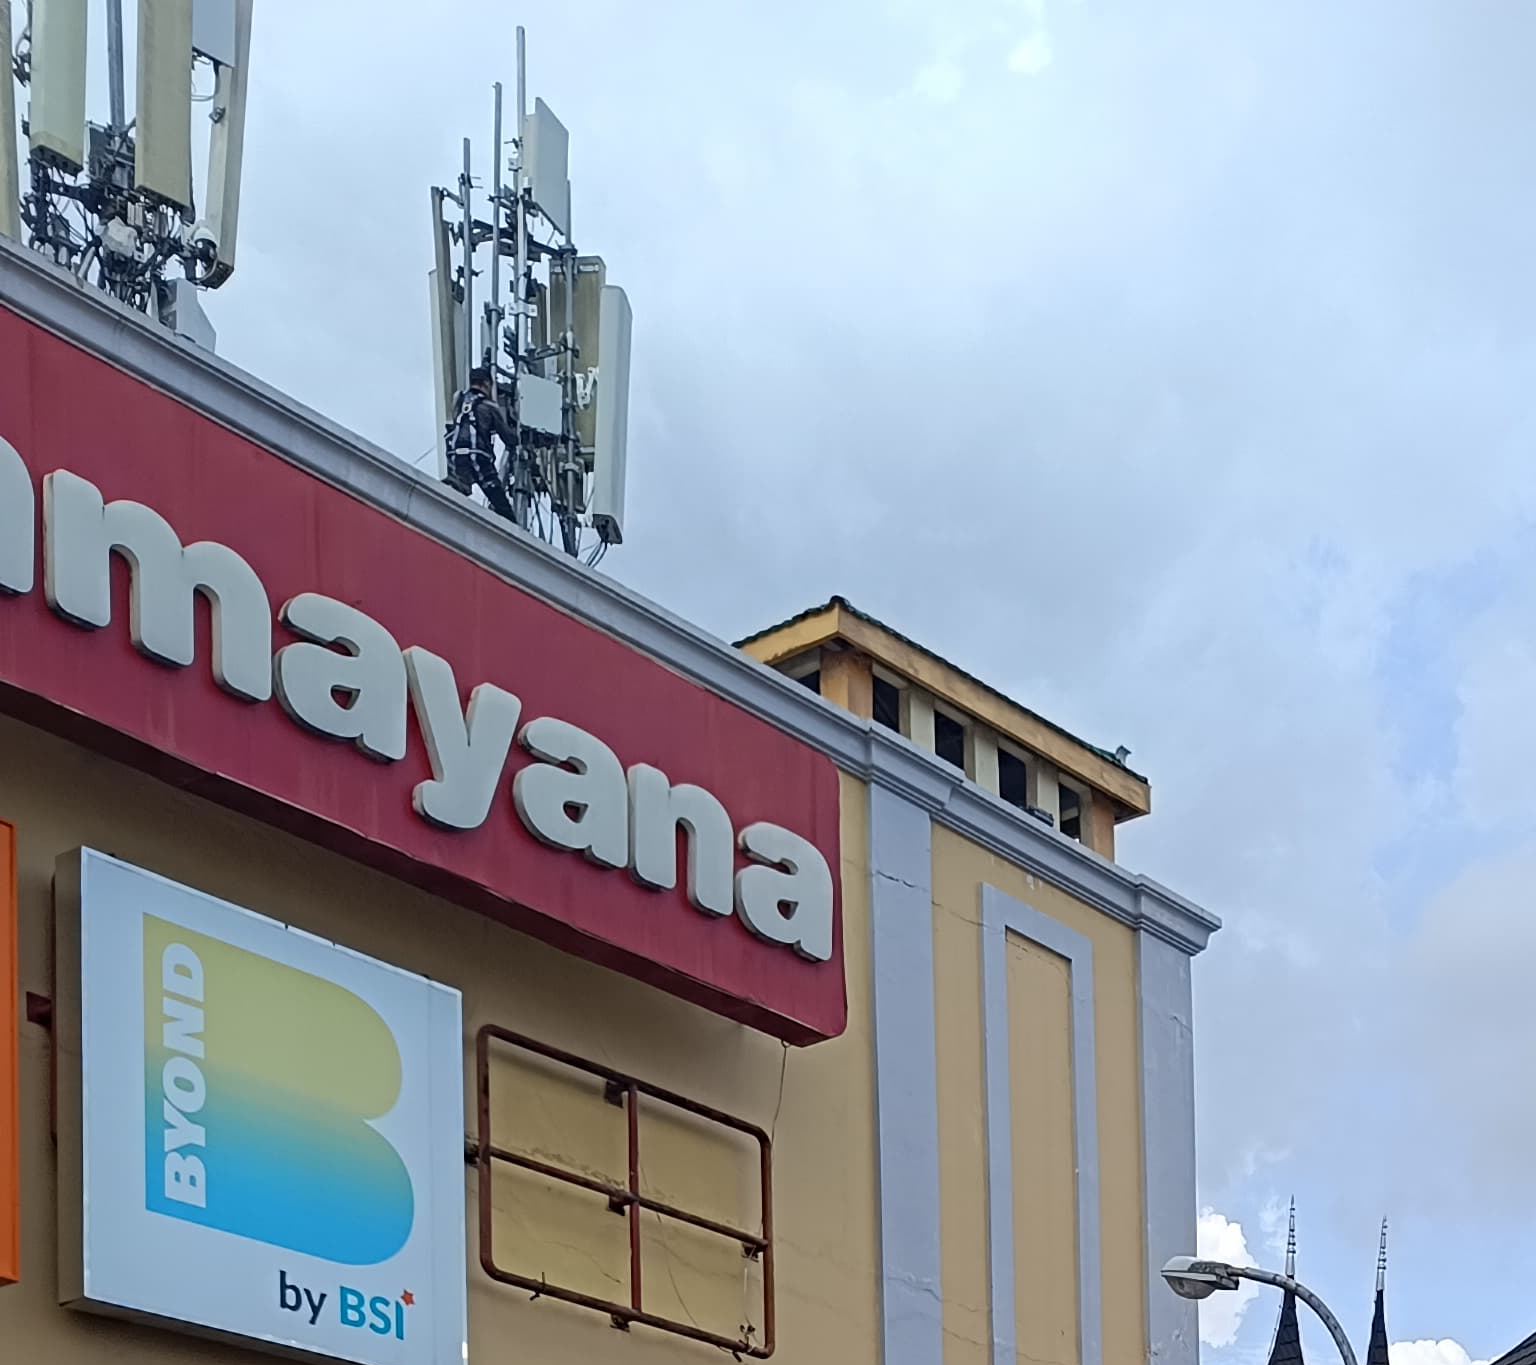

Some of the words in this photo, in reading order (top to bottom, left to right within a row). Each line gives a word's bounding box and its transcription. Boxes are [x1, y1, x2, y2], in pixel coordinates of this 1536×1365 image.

[0, 434, 834, 963] mayana
[162, 942, 208, 1209] BYOND
[279, 1269, 327, 1325] by
[339, 1285, 407, 1341] BSI
